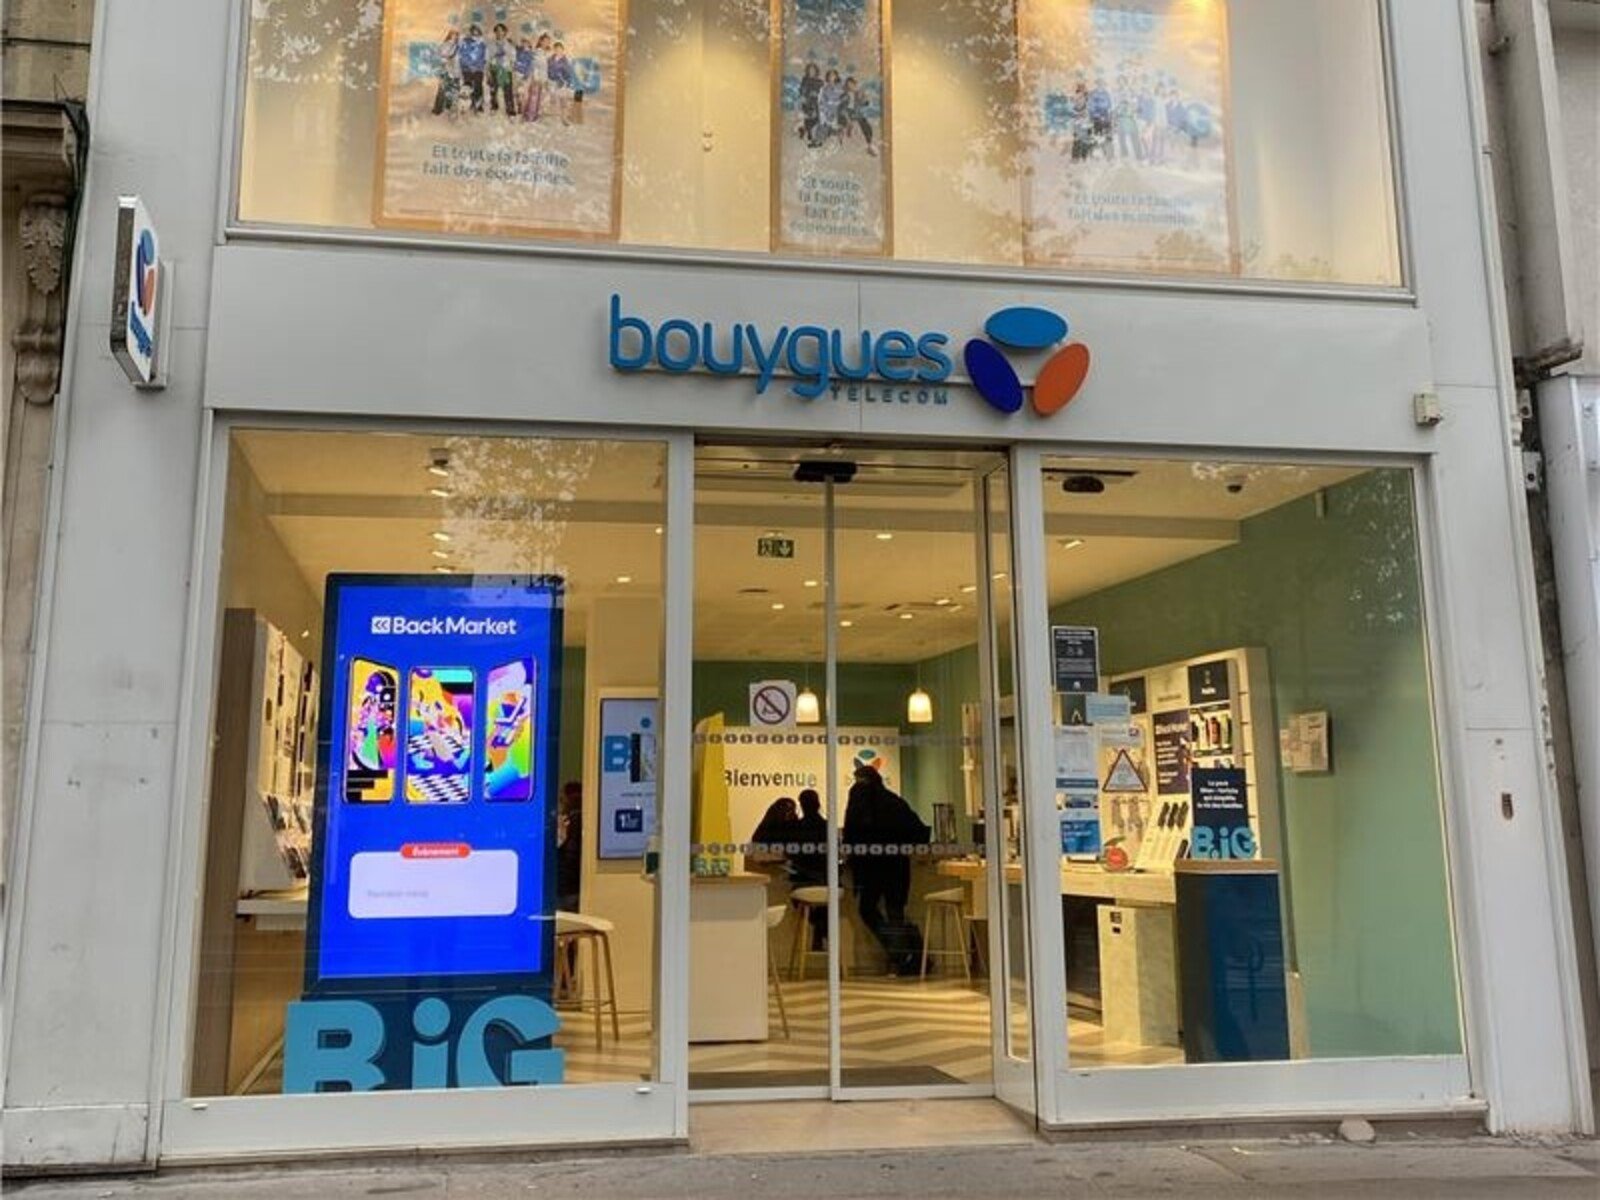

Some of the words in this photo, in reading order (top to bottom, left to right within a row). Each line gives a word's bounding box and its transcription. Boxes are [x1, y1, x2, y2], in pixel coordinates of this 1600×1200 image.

[608, 294, 954, 400] bouygues
[830, 382, 948, 405] TELECOM
[392, 616, 443, 635] Back
[445, 616, 517, 635] Market
